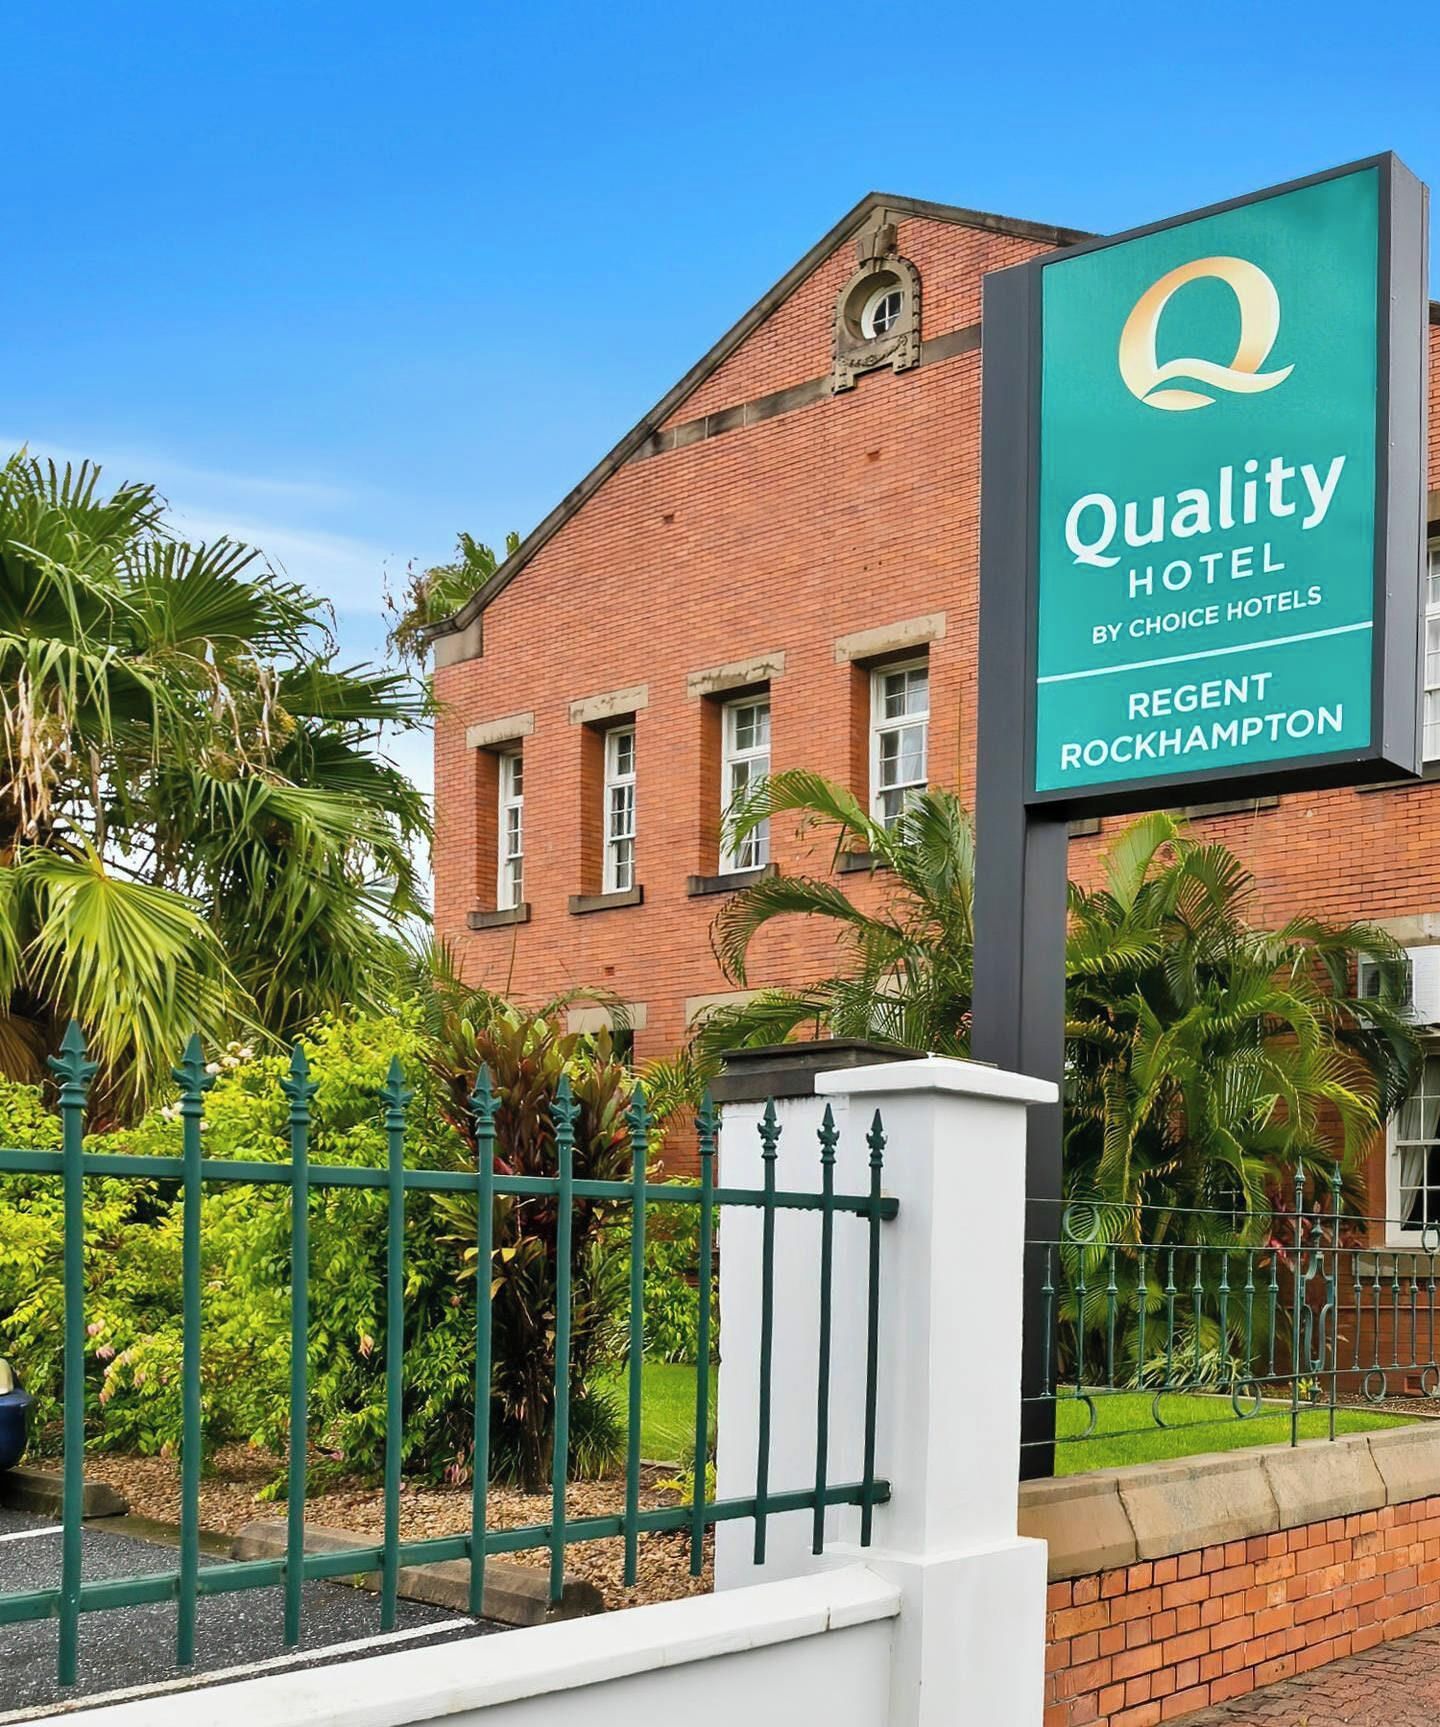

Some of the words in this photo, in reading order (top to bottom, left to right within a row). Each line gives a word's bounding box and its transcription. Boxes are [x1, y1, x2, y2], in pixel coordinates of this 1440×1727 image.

[1118, 256, 1296, 411] Q
[1064, 454, 1347, 568] Quality
[1128, 541, 1286, 599] HOTEL
[1092, 622, 1122, 644] BY
[1129, 605, 1219, 638] CHOICE
[1226, 585, 1322, 621] HOTELS
[1128, 672, 1273, 720] REGENT
[1061, 703, 1344, 770] ROCKHAMPTON
